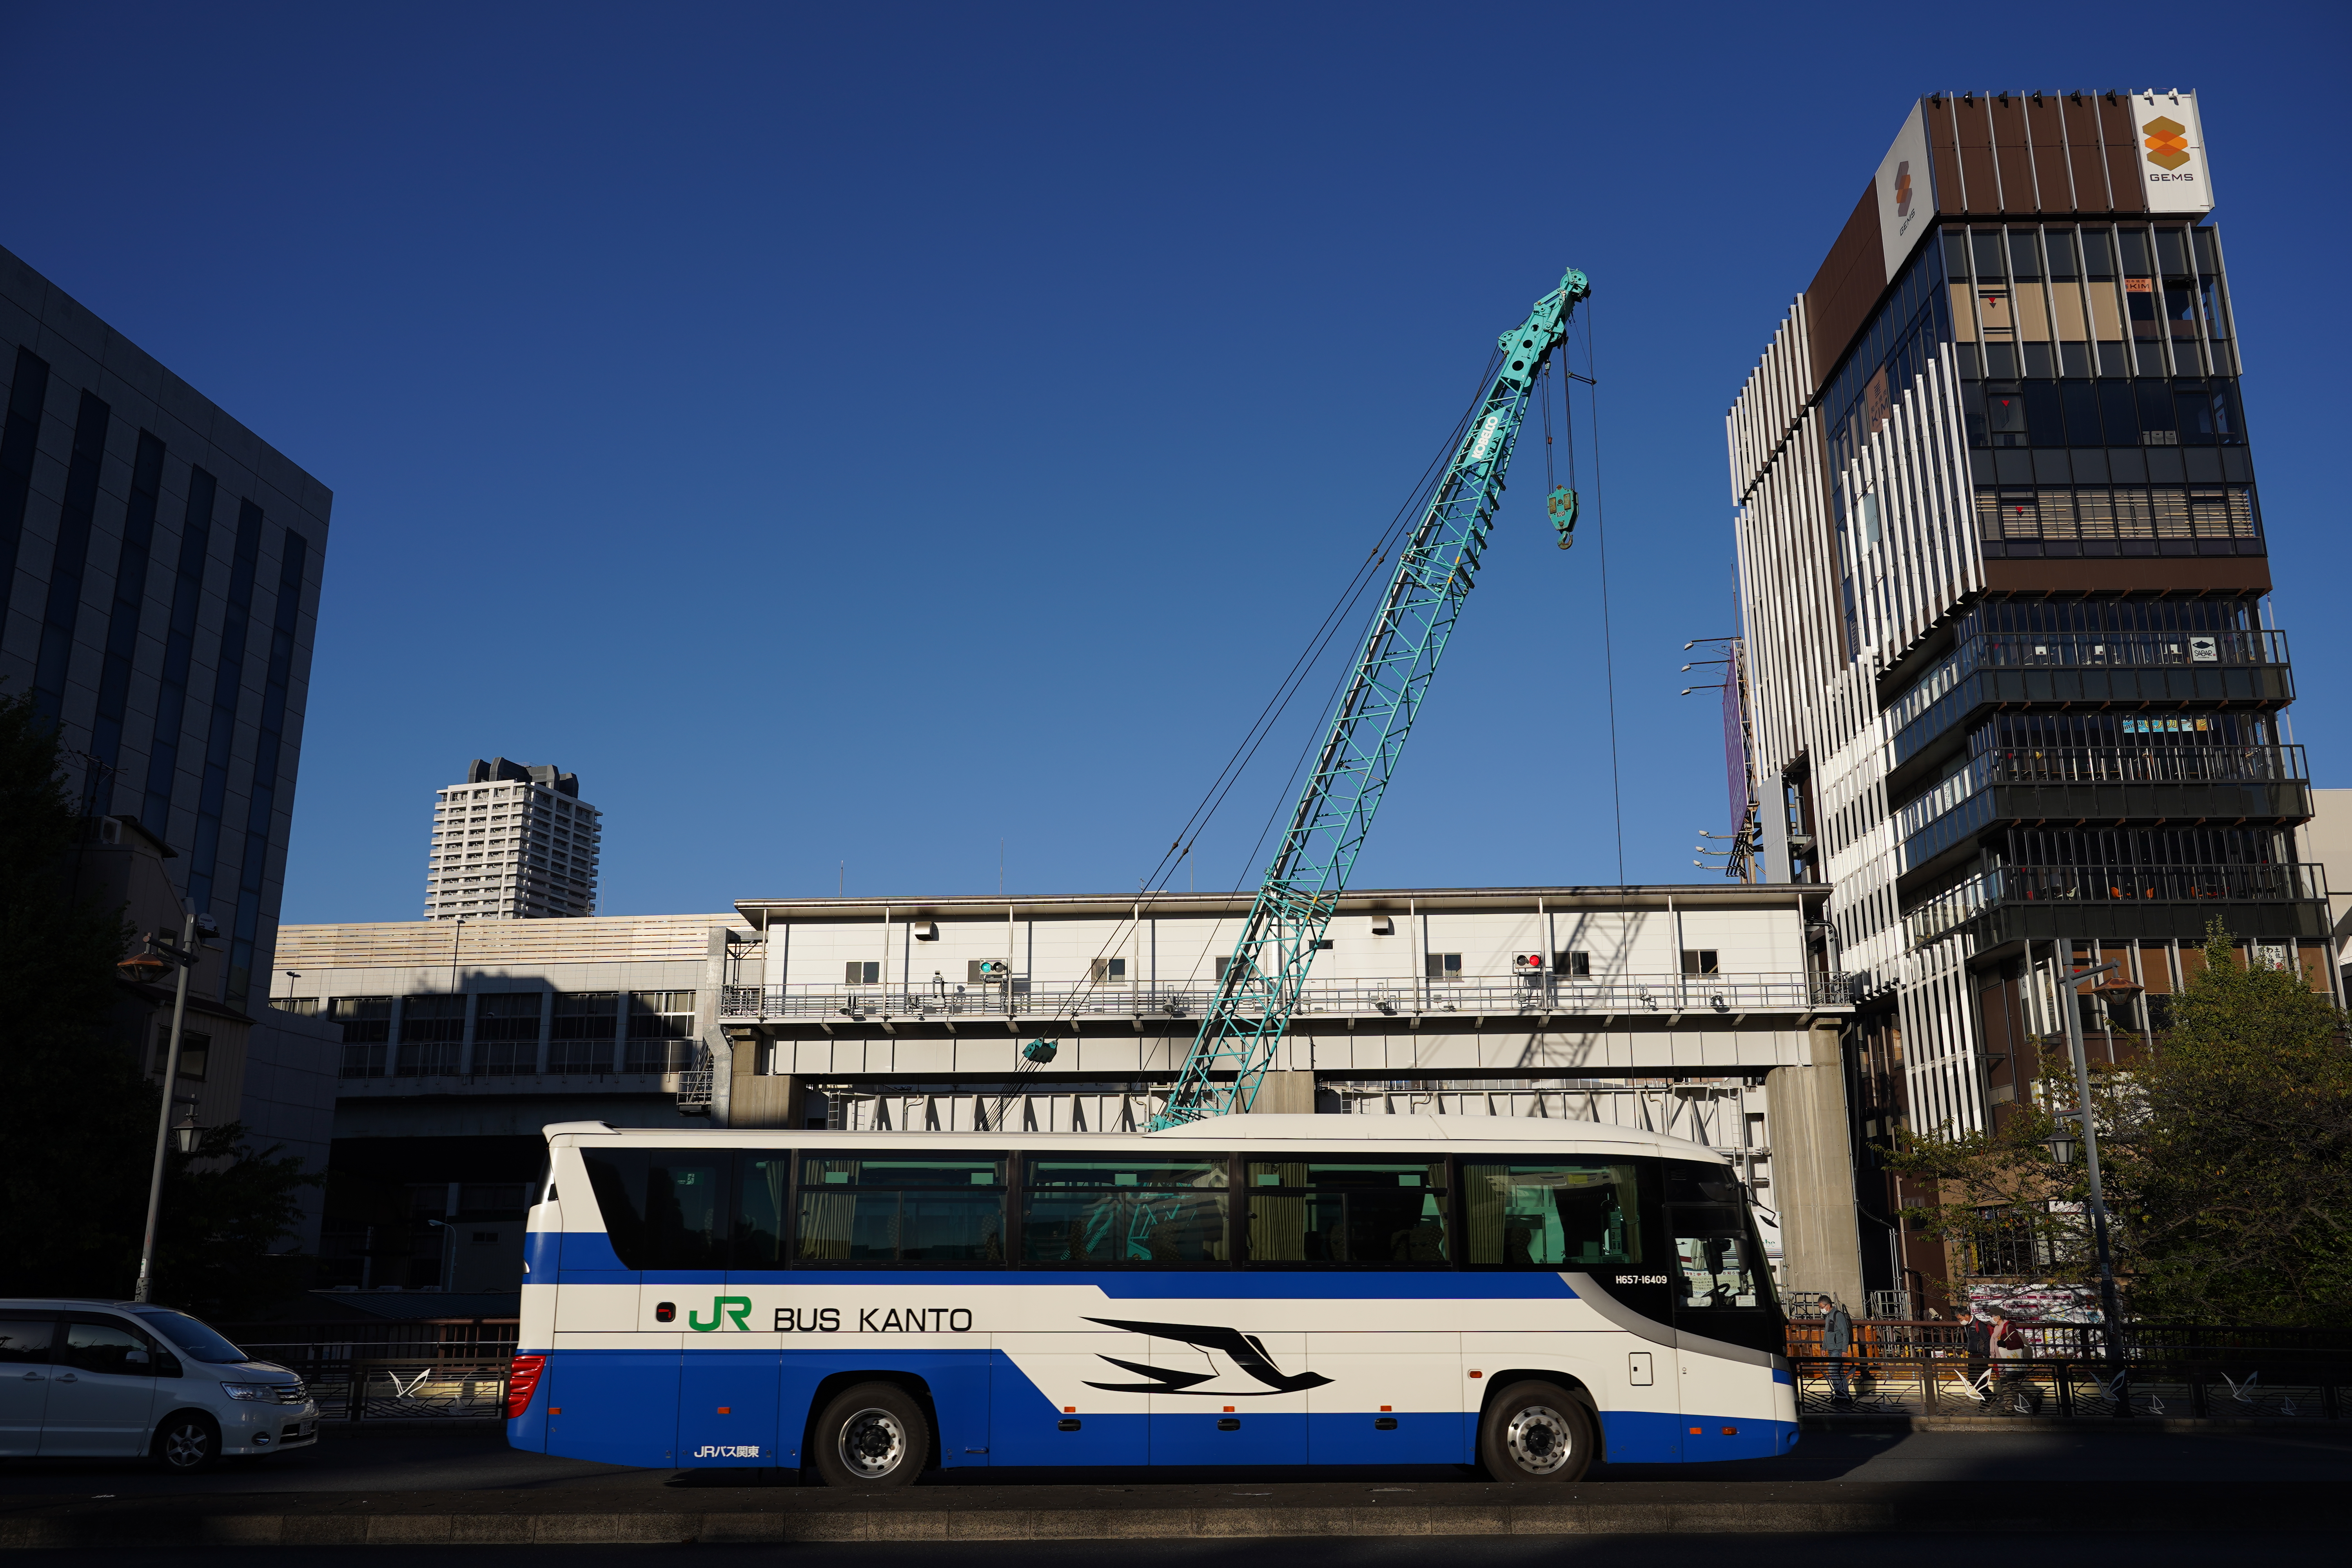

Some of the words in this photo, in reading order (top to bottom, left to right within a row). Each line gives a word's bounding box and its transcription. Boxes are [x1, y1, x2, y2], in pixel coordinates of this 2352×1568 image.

[1900, 208, 1915, 236] GEMS
[1471, 416, 1498, 459] KOBELCO
[2274, 947, 2283, 958] 土佐
[1615, 1275, 1668, 1284] H657-16409
[689, 1296, 751, 1331] JR
[775, 1308, 840, 1332] BUS
[860, 1308, 972, 1332] KANTO
[693, 1445, 760, 1458] JRバス関東
